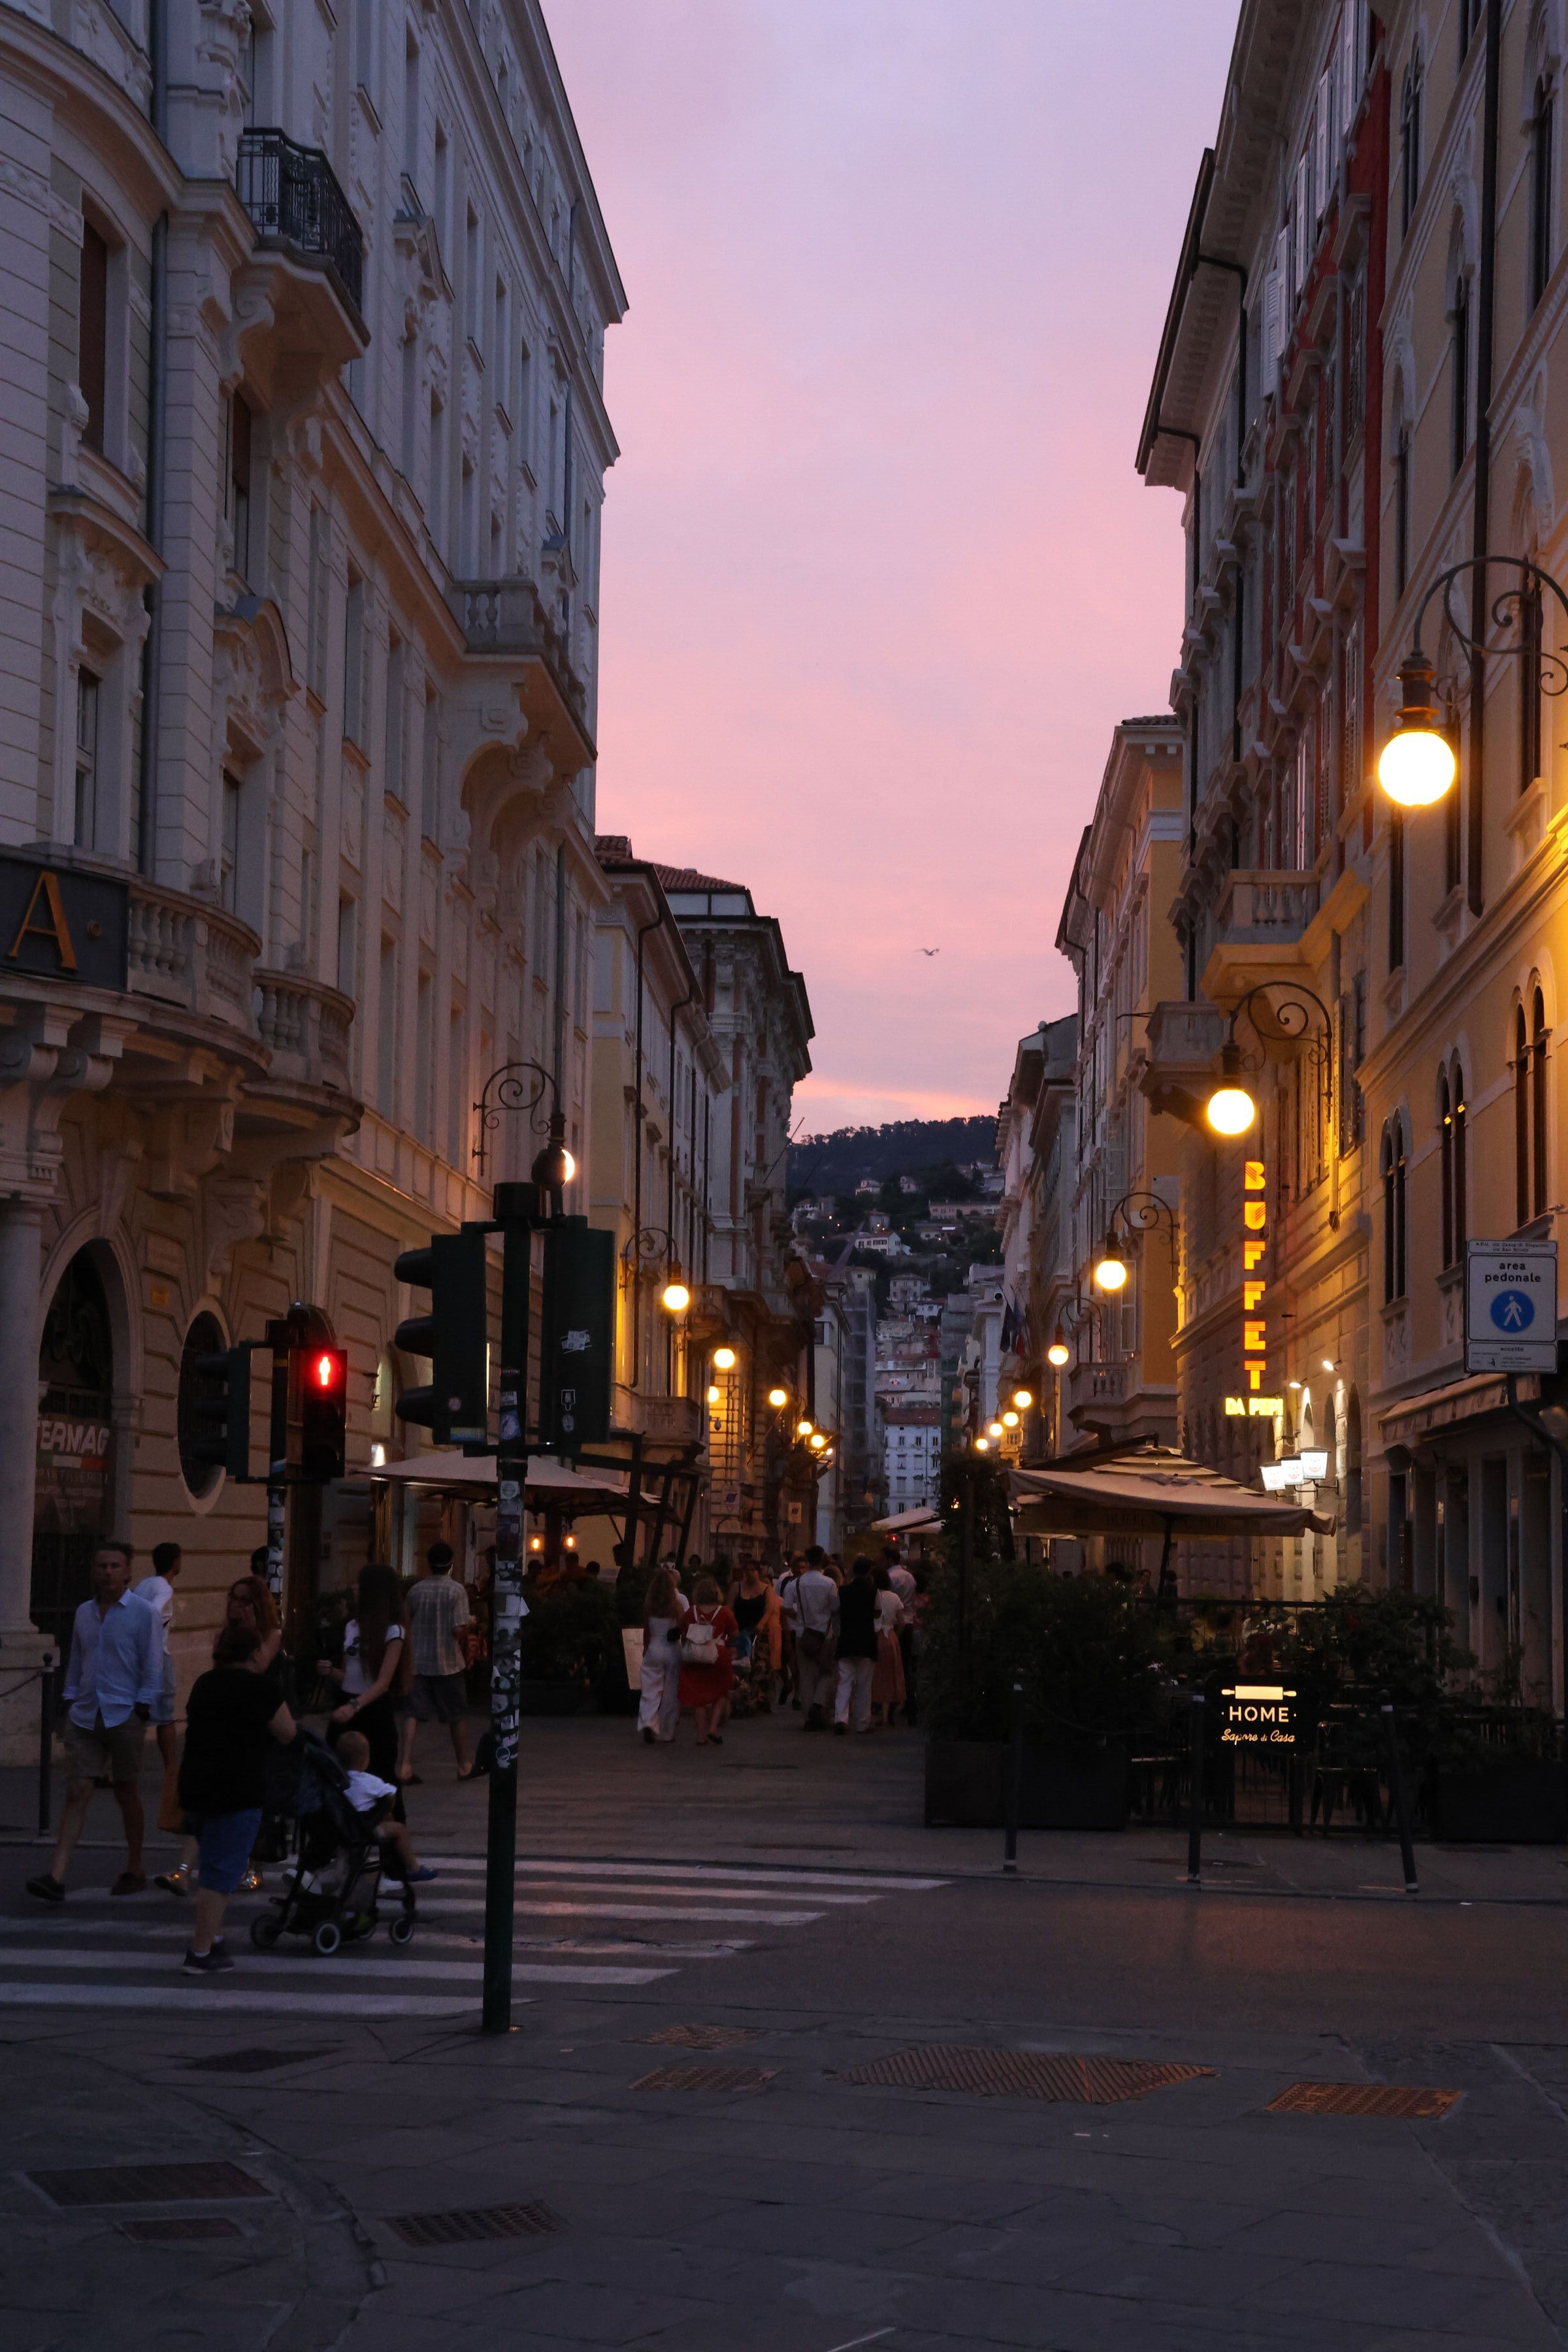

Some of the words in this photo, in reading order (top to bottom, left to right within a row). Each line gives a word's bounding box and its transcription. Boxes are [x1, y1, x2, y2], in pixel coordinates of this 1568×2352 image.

[7, 870, 78, 971] A
[1244, 1161, 1266, 1390] BUFFET
[1484, 1273, 1541, 1283] pedonale
[1225, 1397, 1246, 1416] DA
[1229, 1706, 1289, 1722] HOME
[1270, 1729, 1296, 1742] Casa
